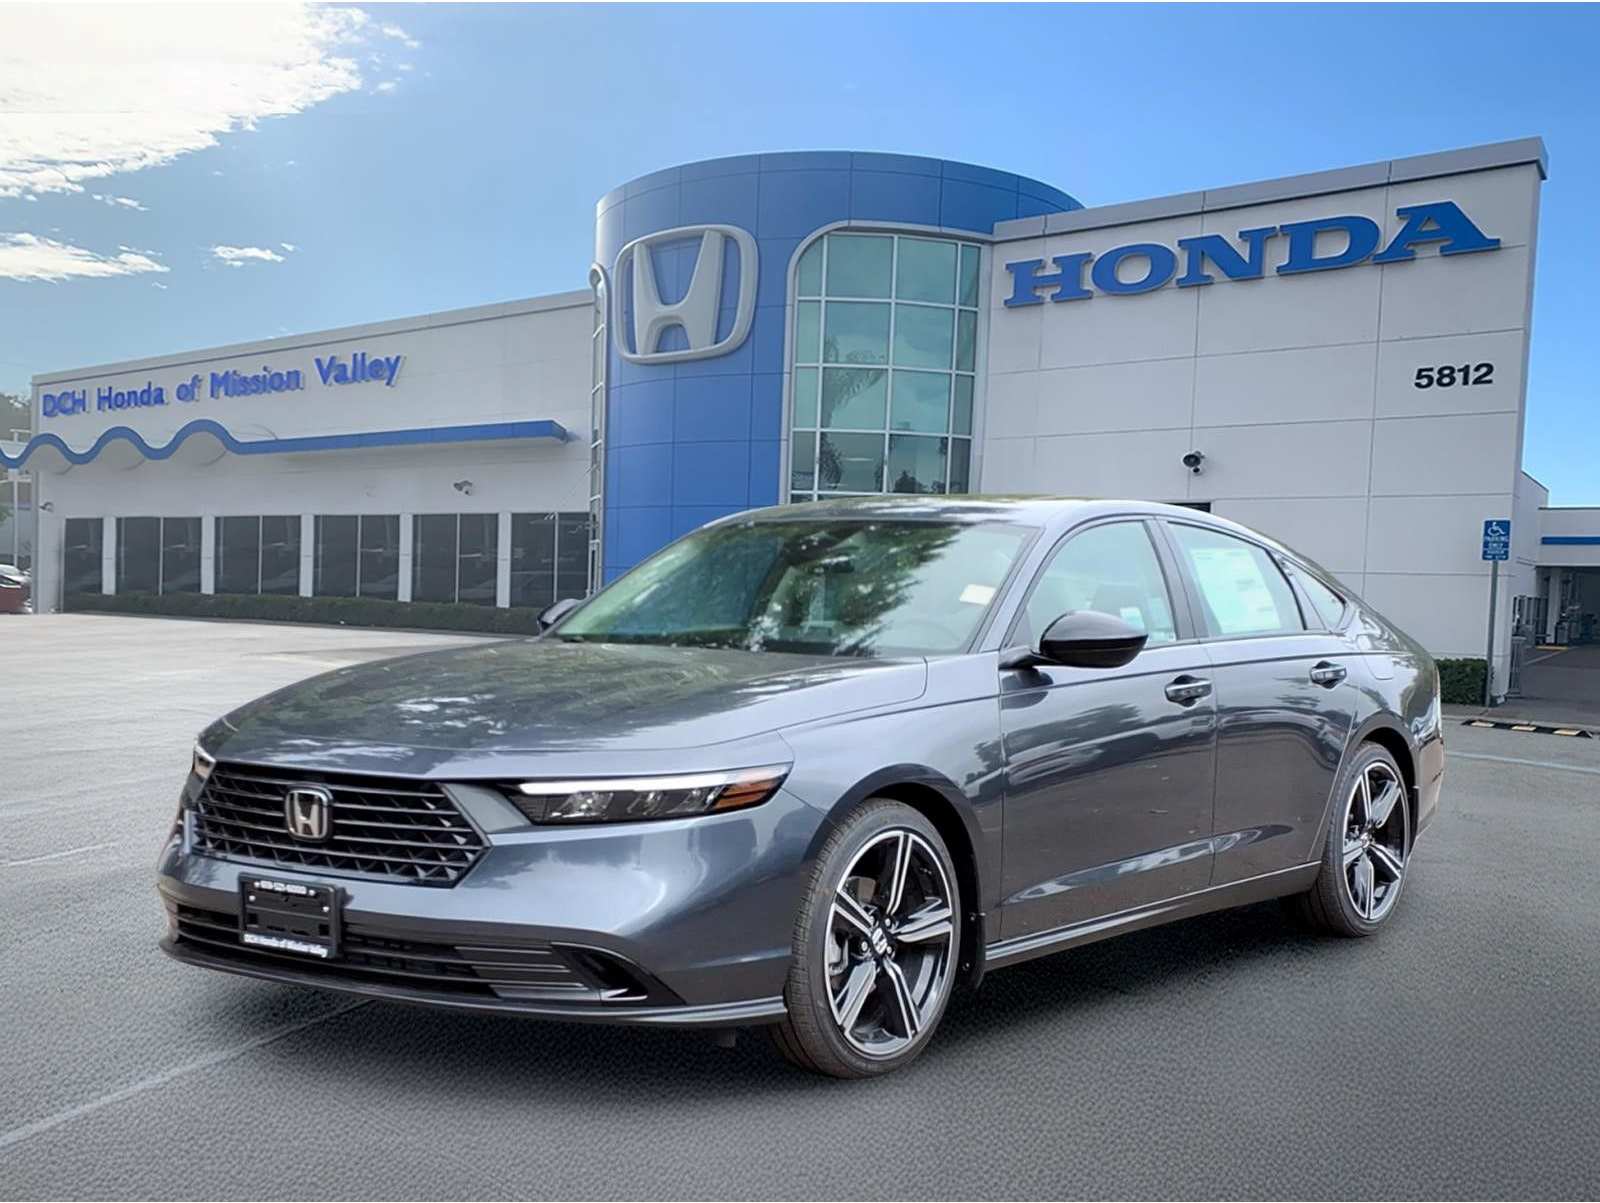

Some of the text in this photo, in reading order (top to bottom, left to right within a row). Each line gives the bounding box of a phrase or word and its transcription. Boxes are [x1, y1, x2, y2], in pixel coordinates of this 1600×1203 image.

[1004, 201, 1501, 308] HONDA
[42, 352, 403, 417] DCH Honda of Mission Valley
[1414, 363, 1495, 389] 5812
